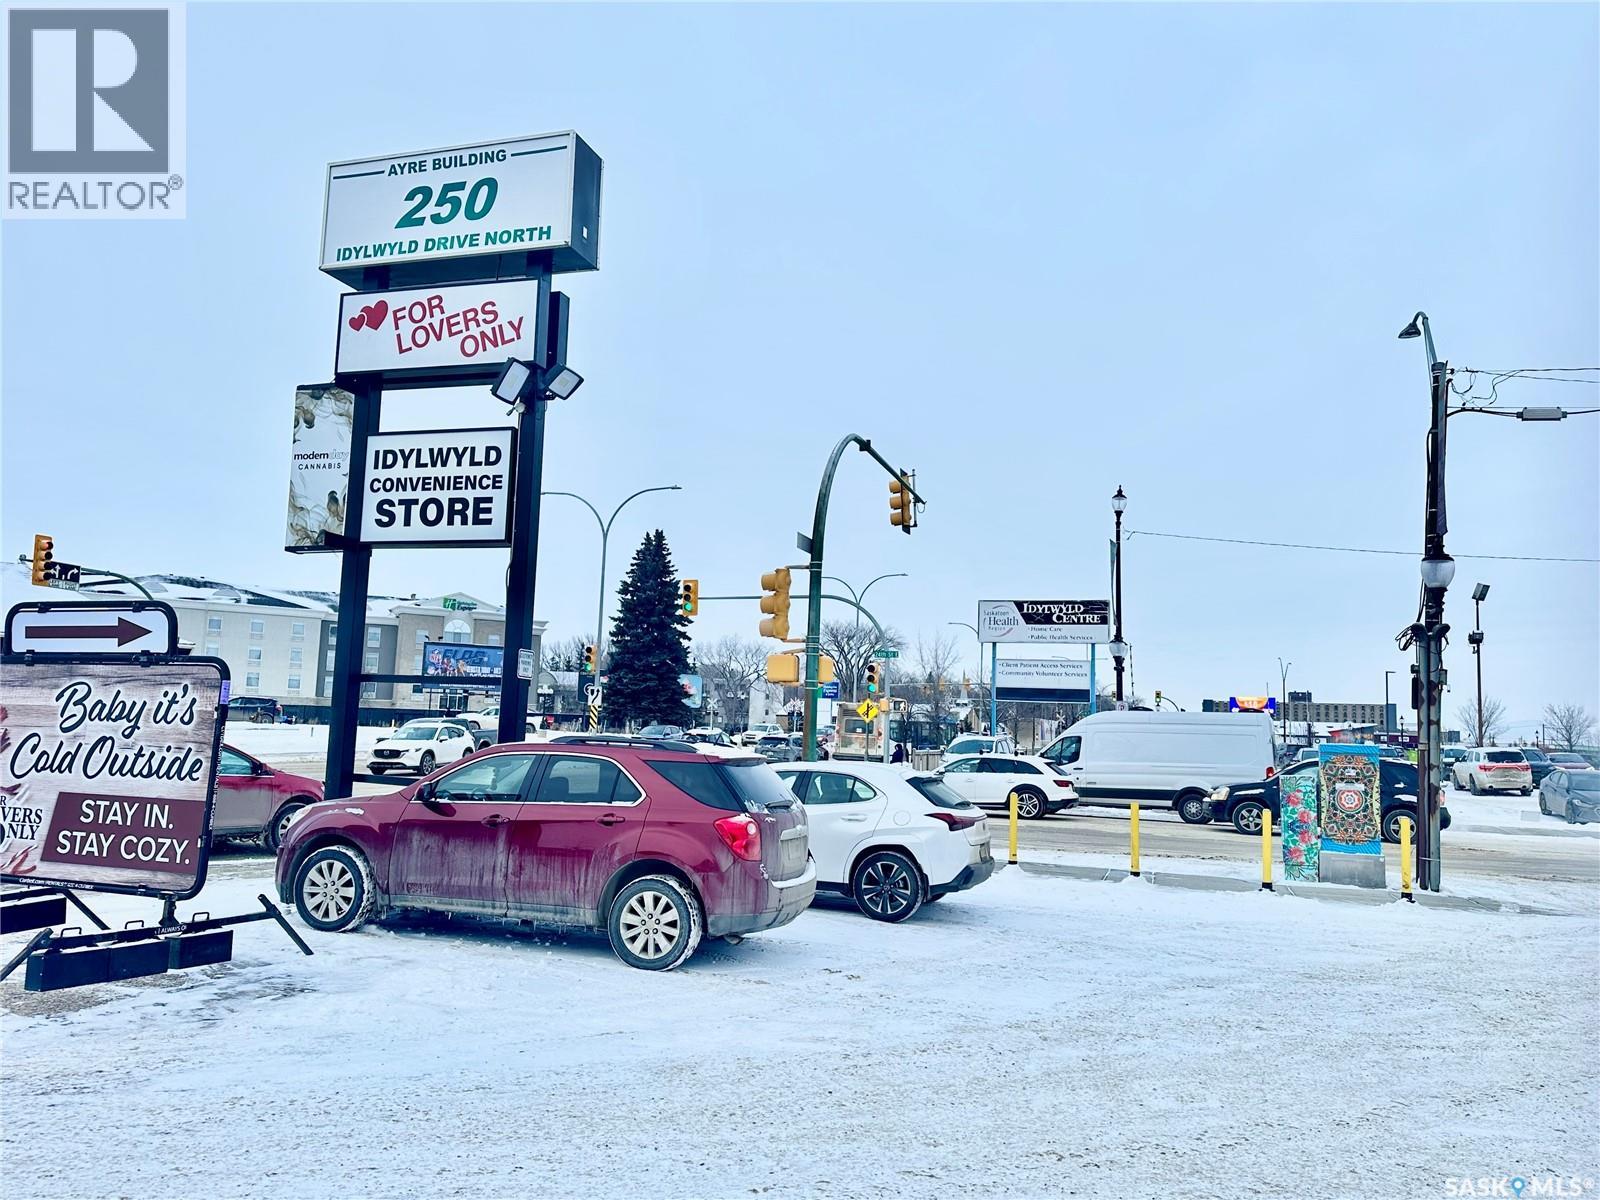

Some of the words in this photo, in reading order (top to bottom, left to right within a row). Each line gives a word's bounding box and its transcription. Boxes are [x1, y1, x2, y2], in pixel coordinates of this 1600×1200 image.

[387, 160, 428, 177] AYRE
[432, 149, 507, 171] BUILDING
[394, 177, 499, 229] 250
[336, 240, 419, 262] IDYLWYLD
[424, 233, 480, 252] DRIVE
[484, 225, 552, 245] NORTH
[392, 294, 445, 331] FOR
[396, 301, 499, 355] LOVERS
[460, 316, 524, 358] ONLY
[298, 462, 342, 471] CANNABIS
[373, 445, 502, 470] IDYLWYLD
[369, 474, 503, 493] CONVENIENCE
[374, 496, 494, 528] STORE
[988, 616, 1019, 626] Health
[1023, 602, 1084, 614] IDYLWYLD
[1052, 612, 1101, 624] CENTRE
[55, 681, 148, 739] Baby
[153, 683, 197, 726] it's
[10, 732, 83, 780] Cold
[82, 735, 204, 782] Outside
[80, 799, 139, 825] STAY
[143, 803, 174, 830] IN.
[56, 830, 115, 858] STAY
[120, 836, 190, 865] COZY.
